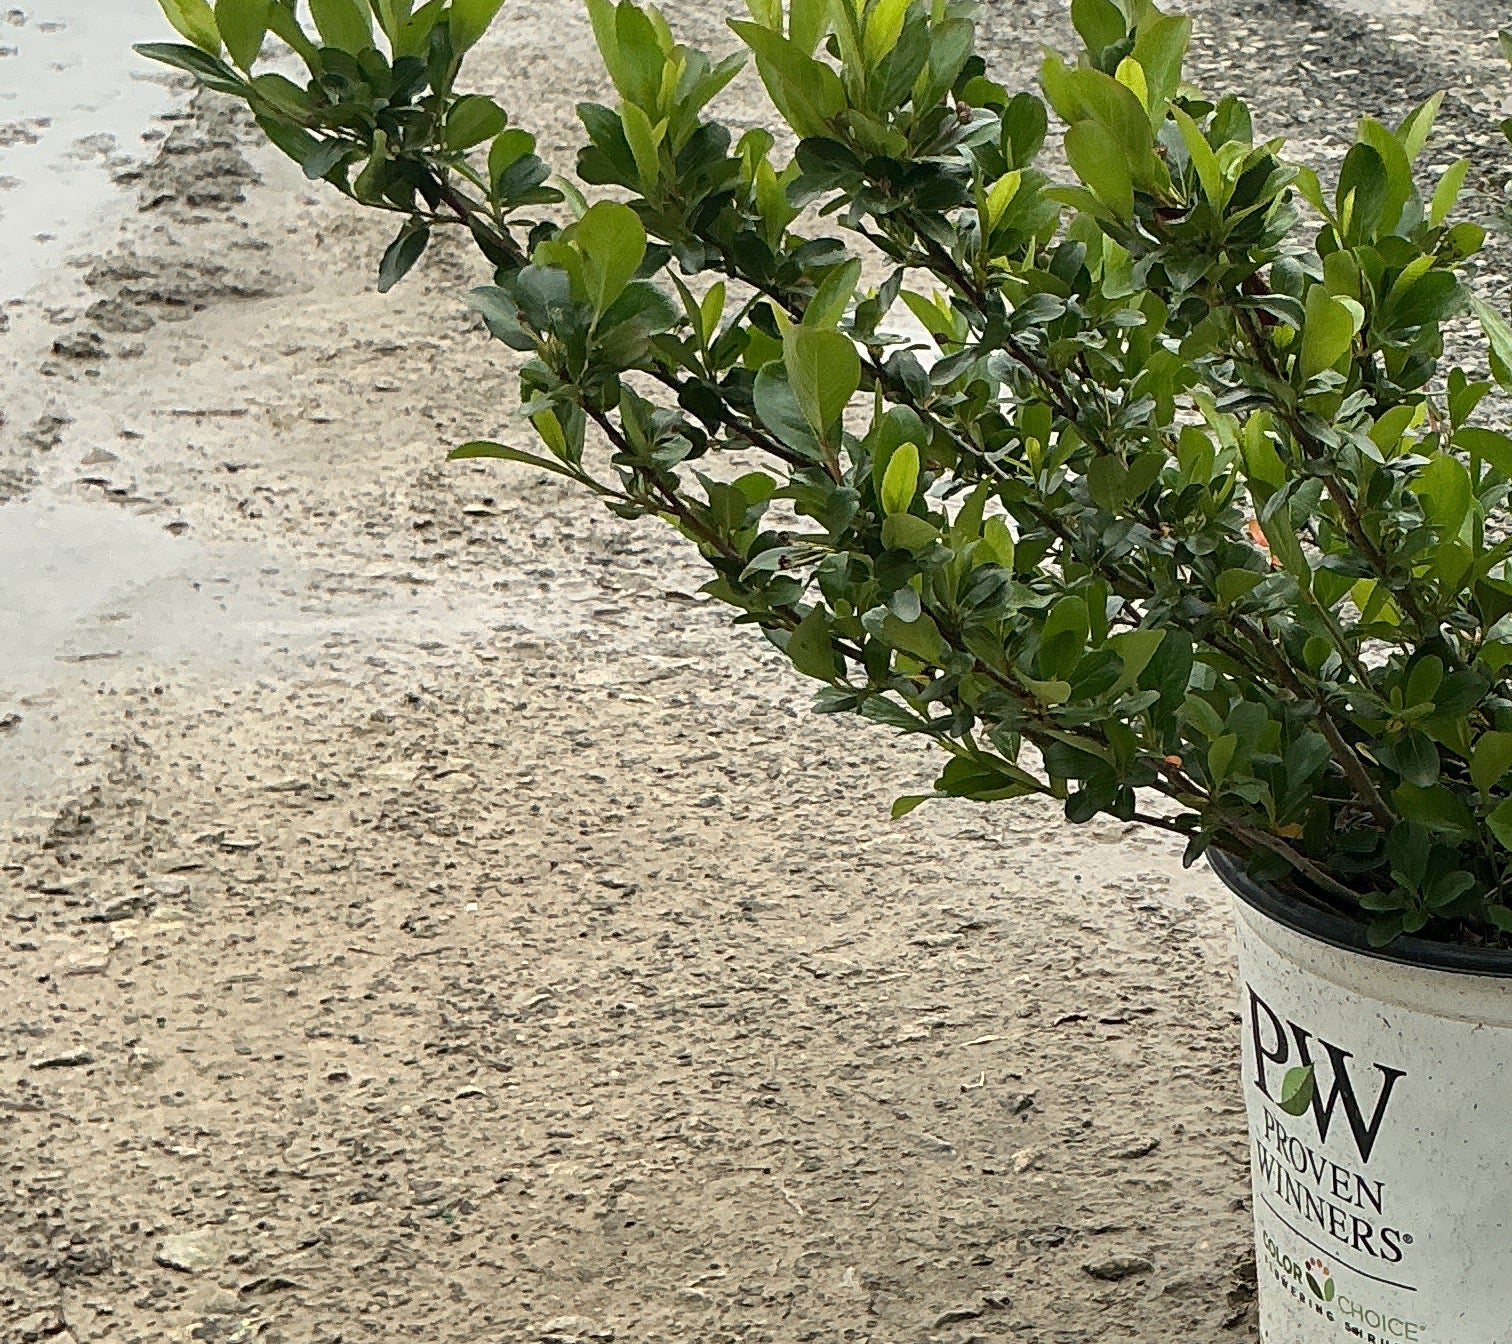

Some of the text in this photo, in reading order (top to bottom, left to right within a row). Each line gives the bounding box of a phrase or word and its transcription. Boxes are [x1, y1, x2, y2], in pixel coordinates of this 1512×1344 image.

[1246, 981, 1407, 1164] PW
[1263, 1106, 1385, 1215] PROVEN
[1263, 1230, 1303, 1284] COLOR
